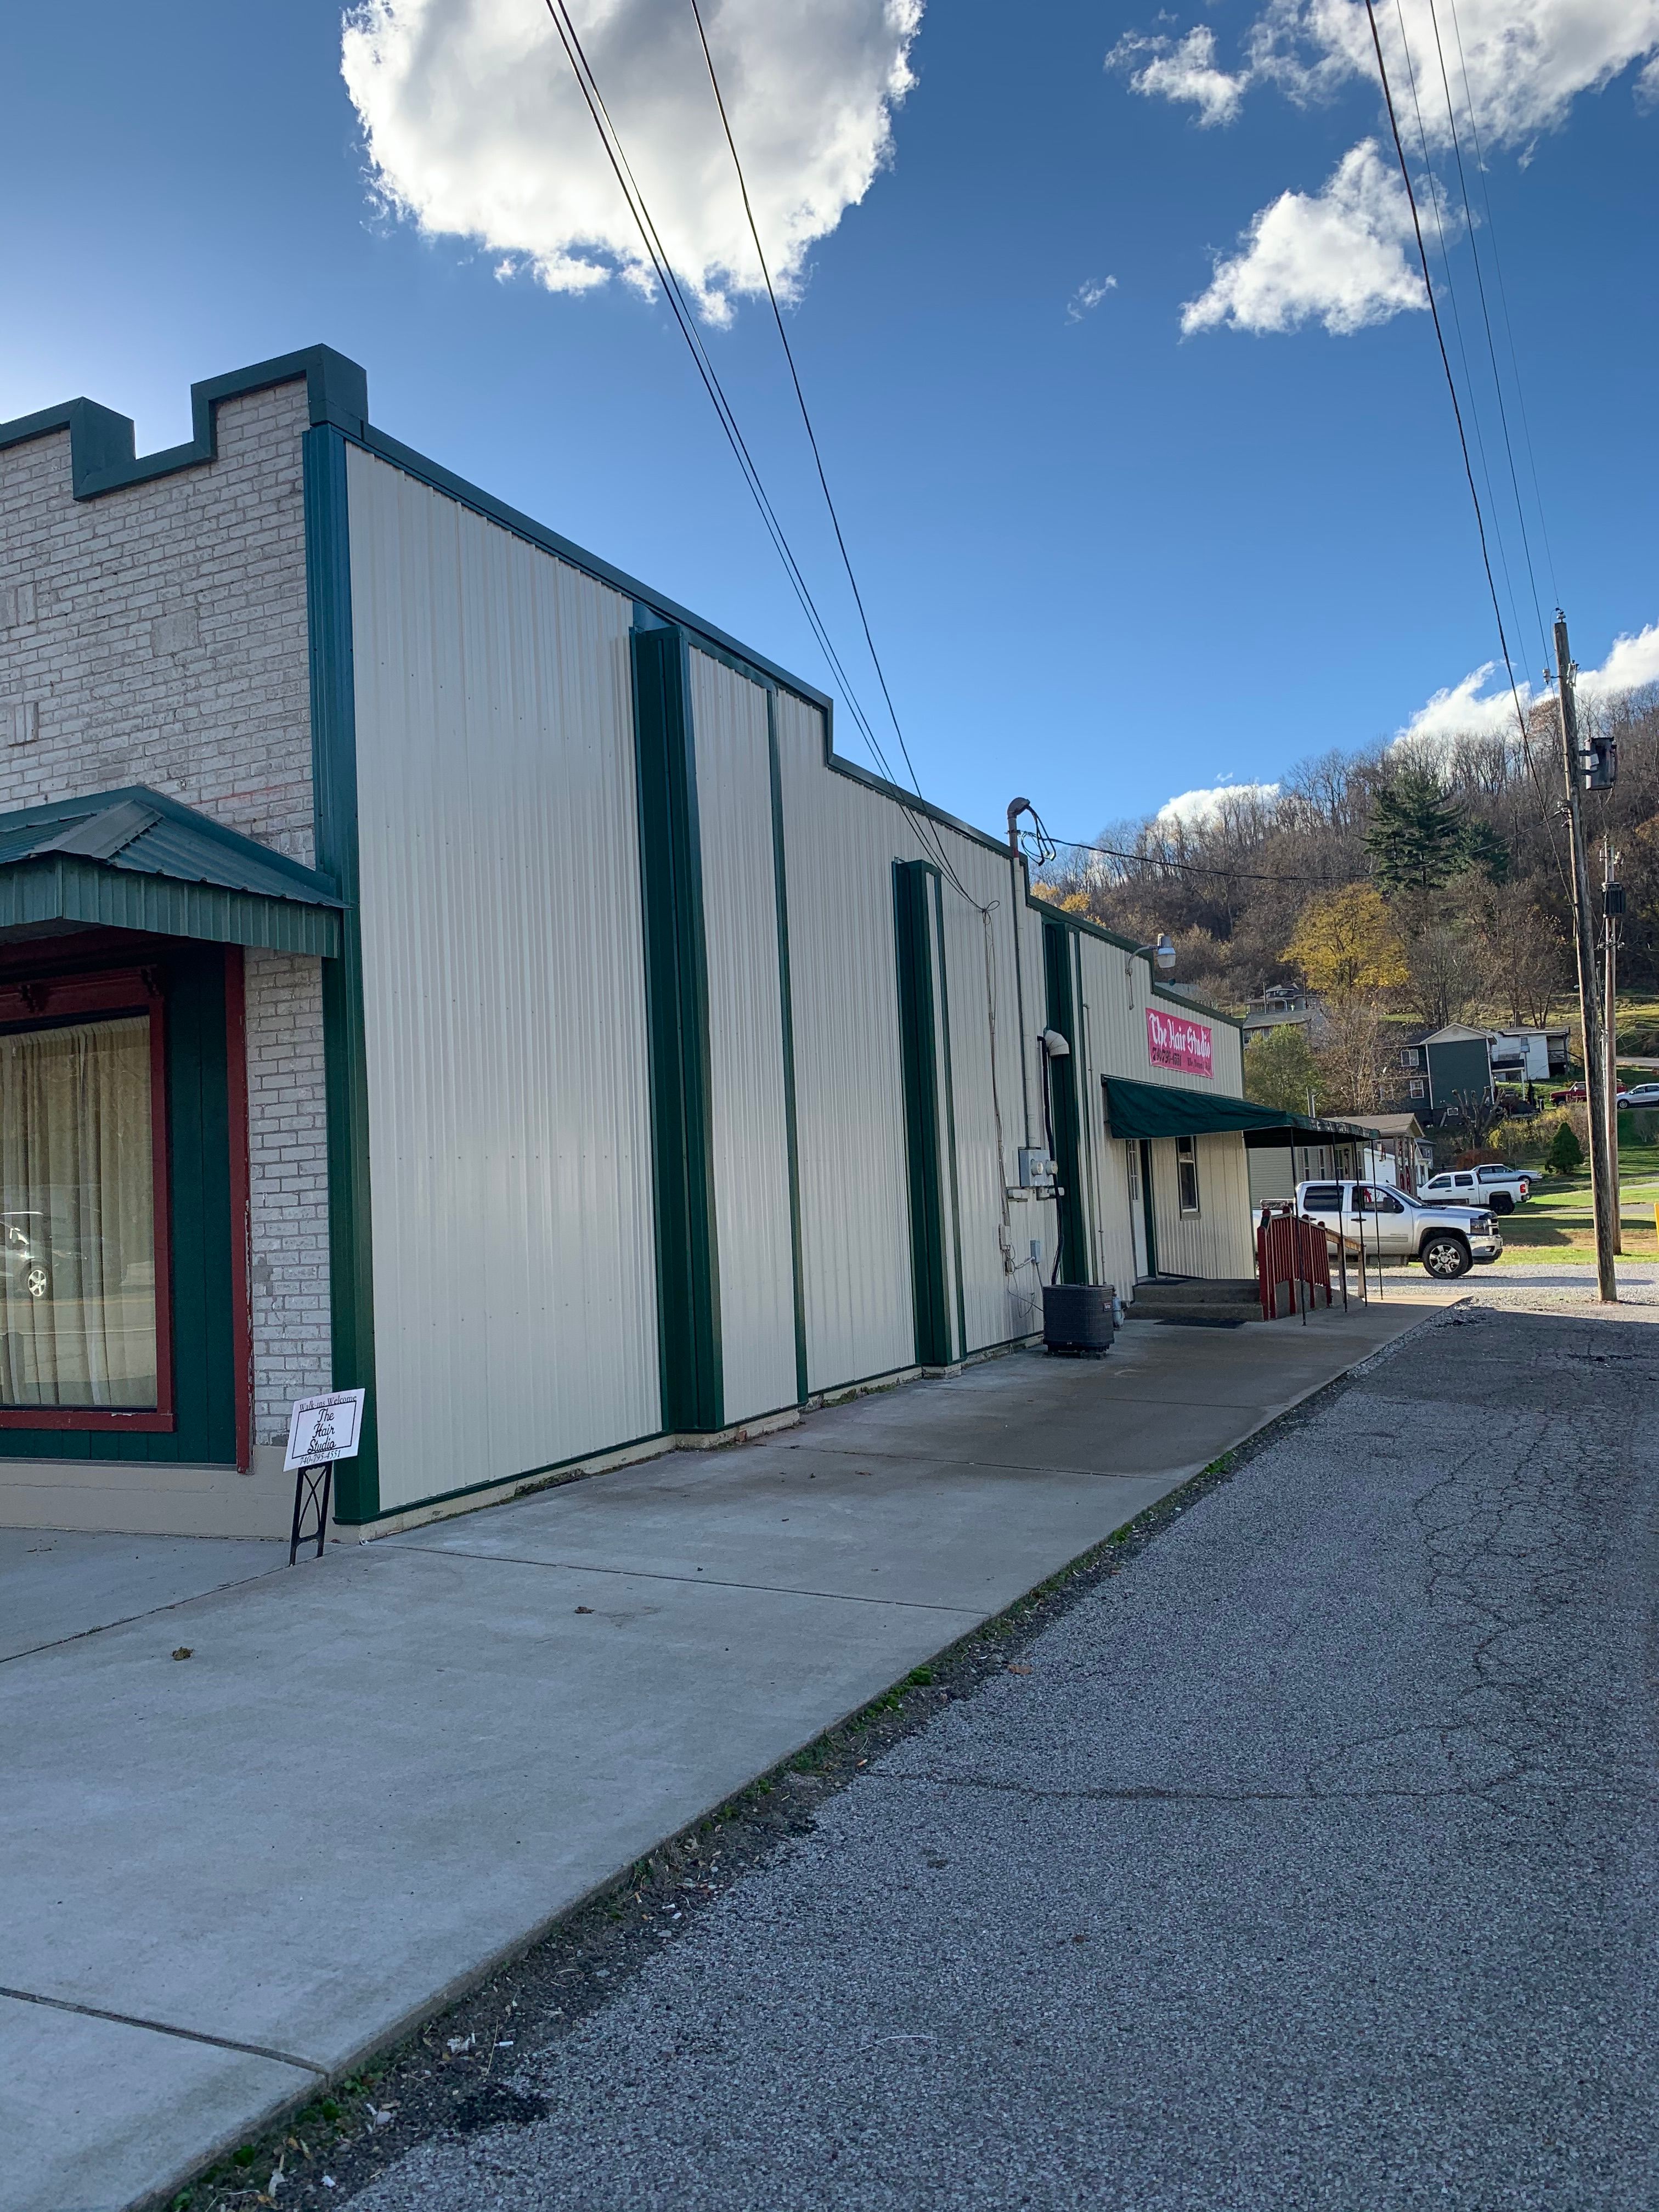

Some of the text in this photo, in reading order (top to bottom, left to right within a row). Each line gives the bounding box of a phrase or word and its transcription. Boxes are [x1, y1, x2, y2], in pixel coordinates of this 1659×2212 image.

[1149, 1013, 1211, 1058] The Hair Studio
[300, 1395, 357, 1412] Walk-ins Welcome
[317, 1408, 335, 1423] The
[312, 1423, 335, 1438] Hair
[307, 1436, 337, 1454] Studio
[300, 1449, 341, 1466] 740-795-4551
